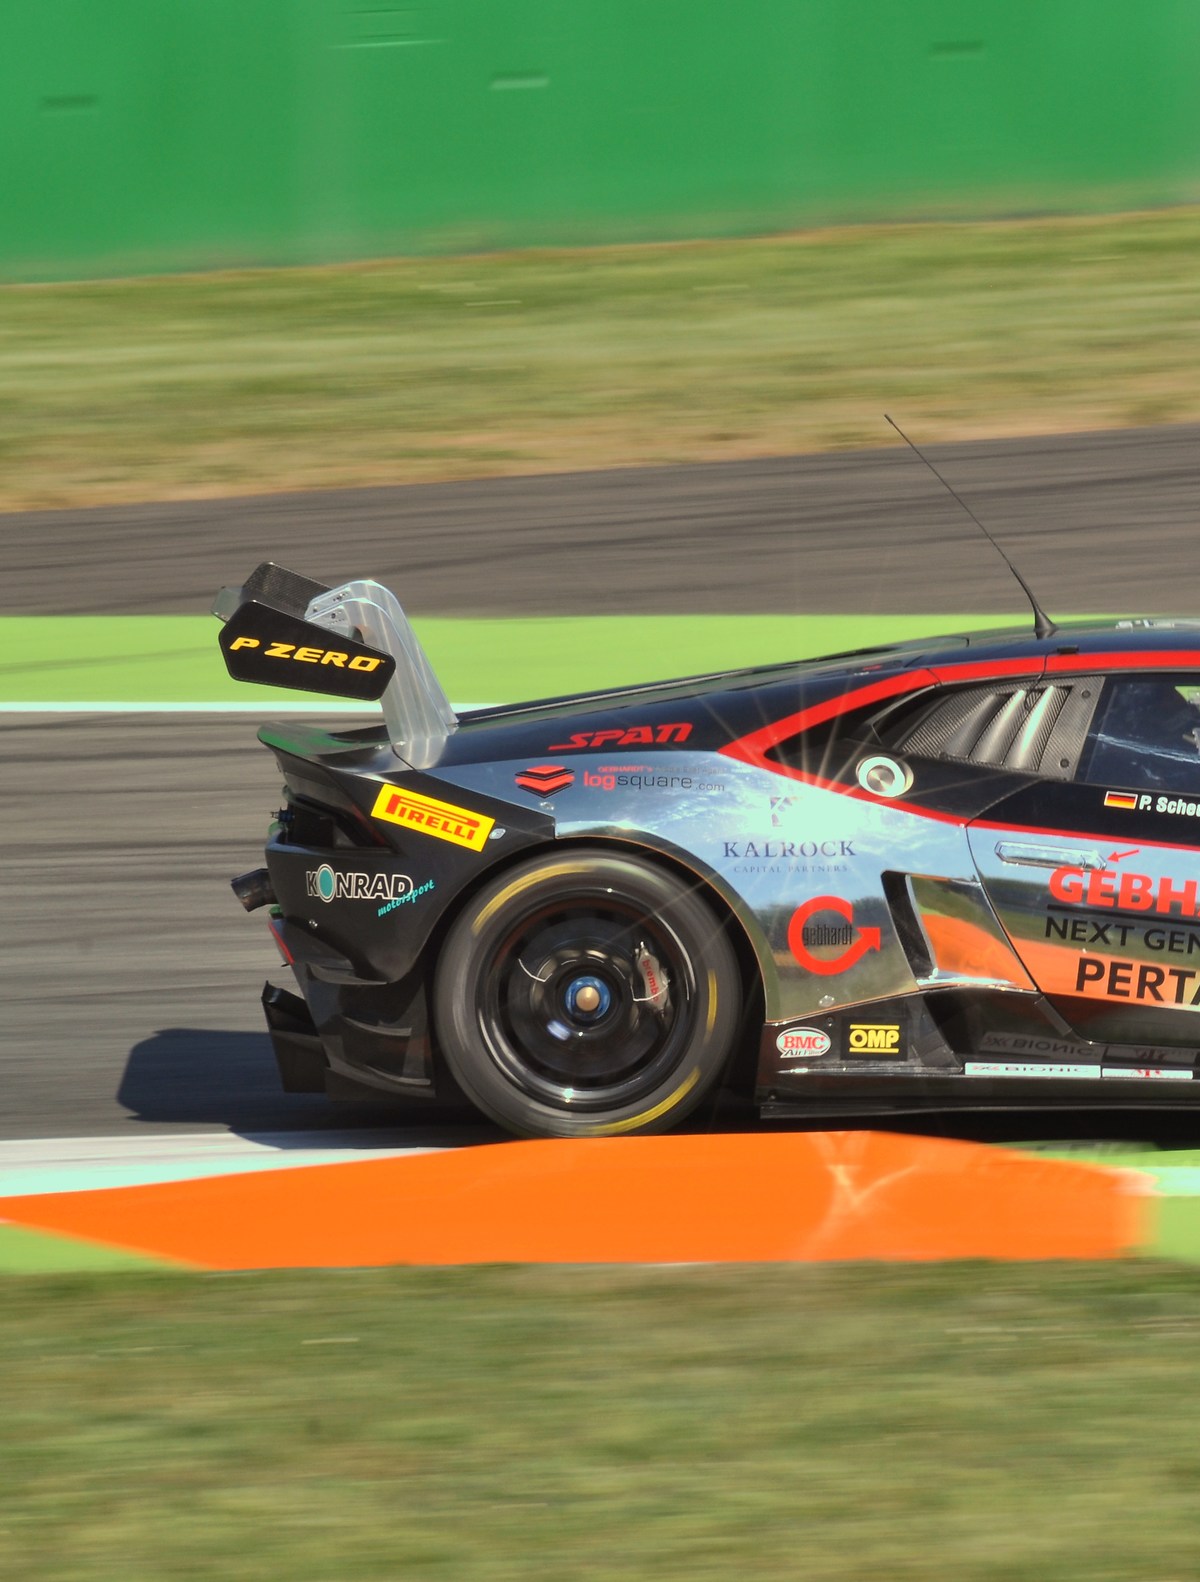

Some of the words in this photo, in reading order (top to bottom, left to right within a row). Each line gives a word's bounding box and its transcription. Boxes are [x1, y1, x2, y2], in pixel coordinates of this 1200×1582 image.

[230, 637, 260, 650] P
[264, 642, 382, 672] ZERO
[1139, 795, 1152, 811] P.
[385, 793, 481, 841] PIRELLI
[723, 840, 856, 858] KALROCK
[734, 865, 782, 873] CAPITAL
[788, 864, 848, 873] PARTNERS
[305, 863, 414, 903] KONRAD
[377, 879, 435, 917] motorsport
[802, 924, 853, 946] gebhardt
[1045, 916, 1135, 947] NEXT
[783, 1036, 825, 1049] BMC
[849, 1029, 900, 1048] OMP
